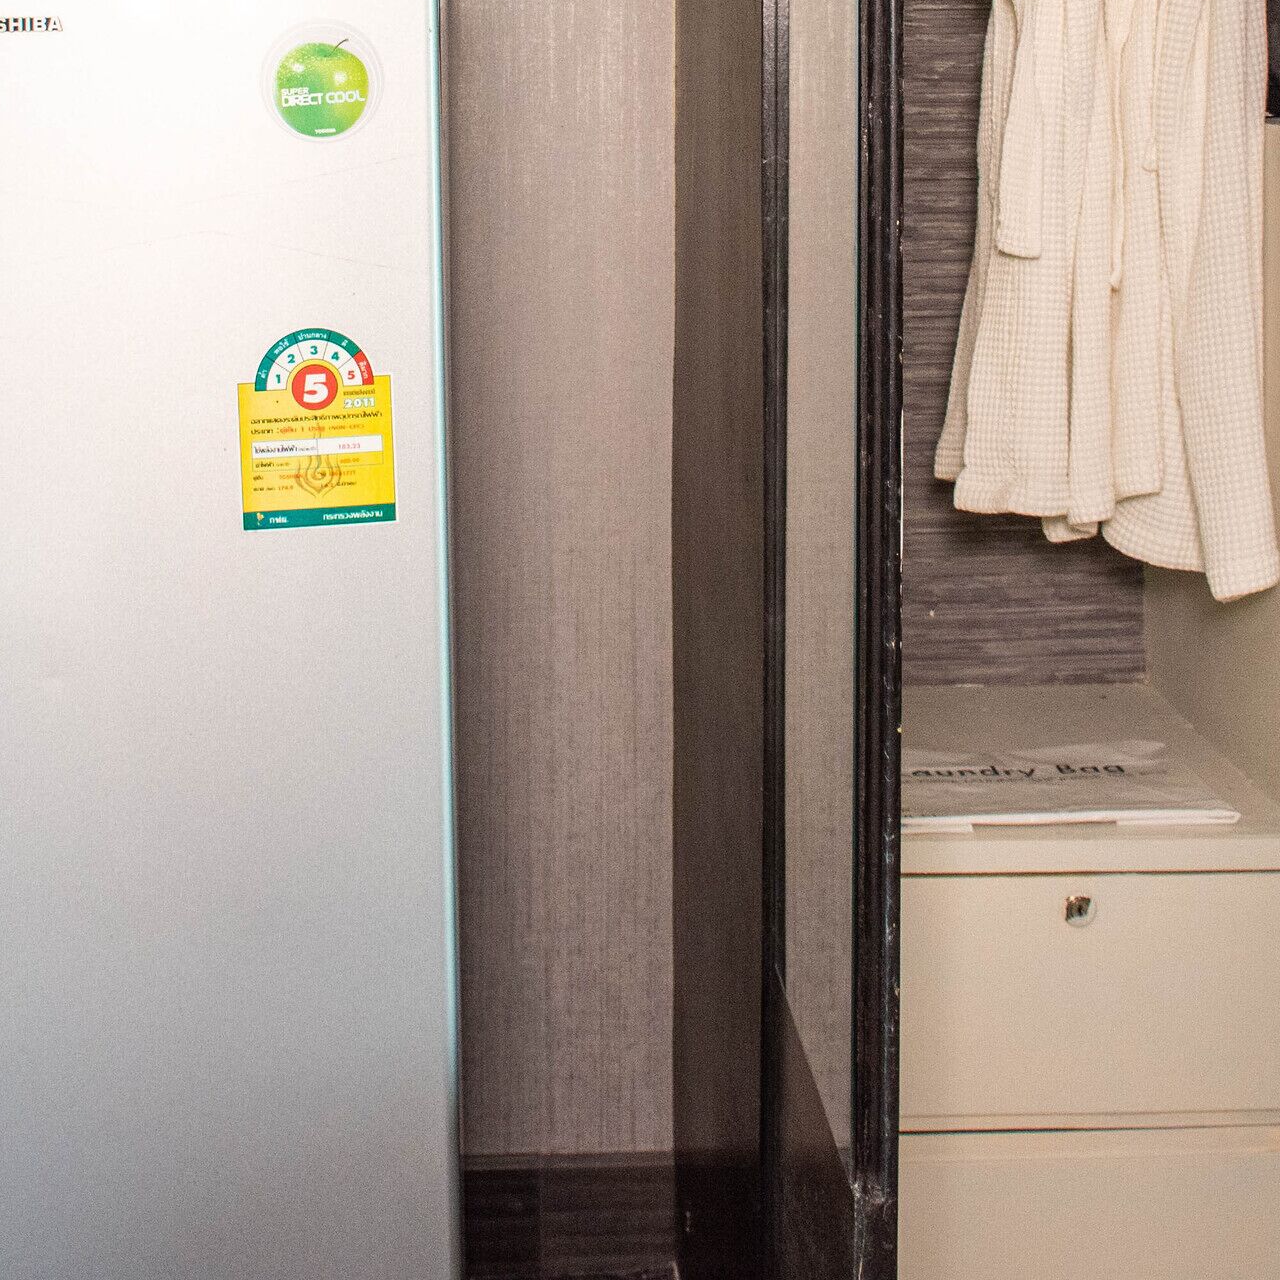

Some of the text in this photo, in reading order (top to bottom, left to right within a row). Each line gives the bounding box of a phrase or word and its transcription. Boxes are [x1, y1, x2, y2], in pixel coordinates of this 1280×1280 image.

[281, 87, 309, 96] SUPER
[282, 89, 365, 108] DIRECT COOL
[310, 345, 318, 355] 3
[287, 354, 296, 364] 2
[331, 351, 340, 361] 4
[276, 374, 281, 384] 1
[347, 370, 355, 380] 5
[303, 373, 329, 404] 5
[343, 397, 375, 409] 2011
[900, 763, 1127, 779] aundry Bag
